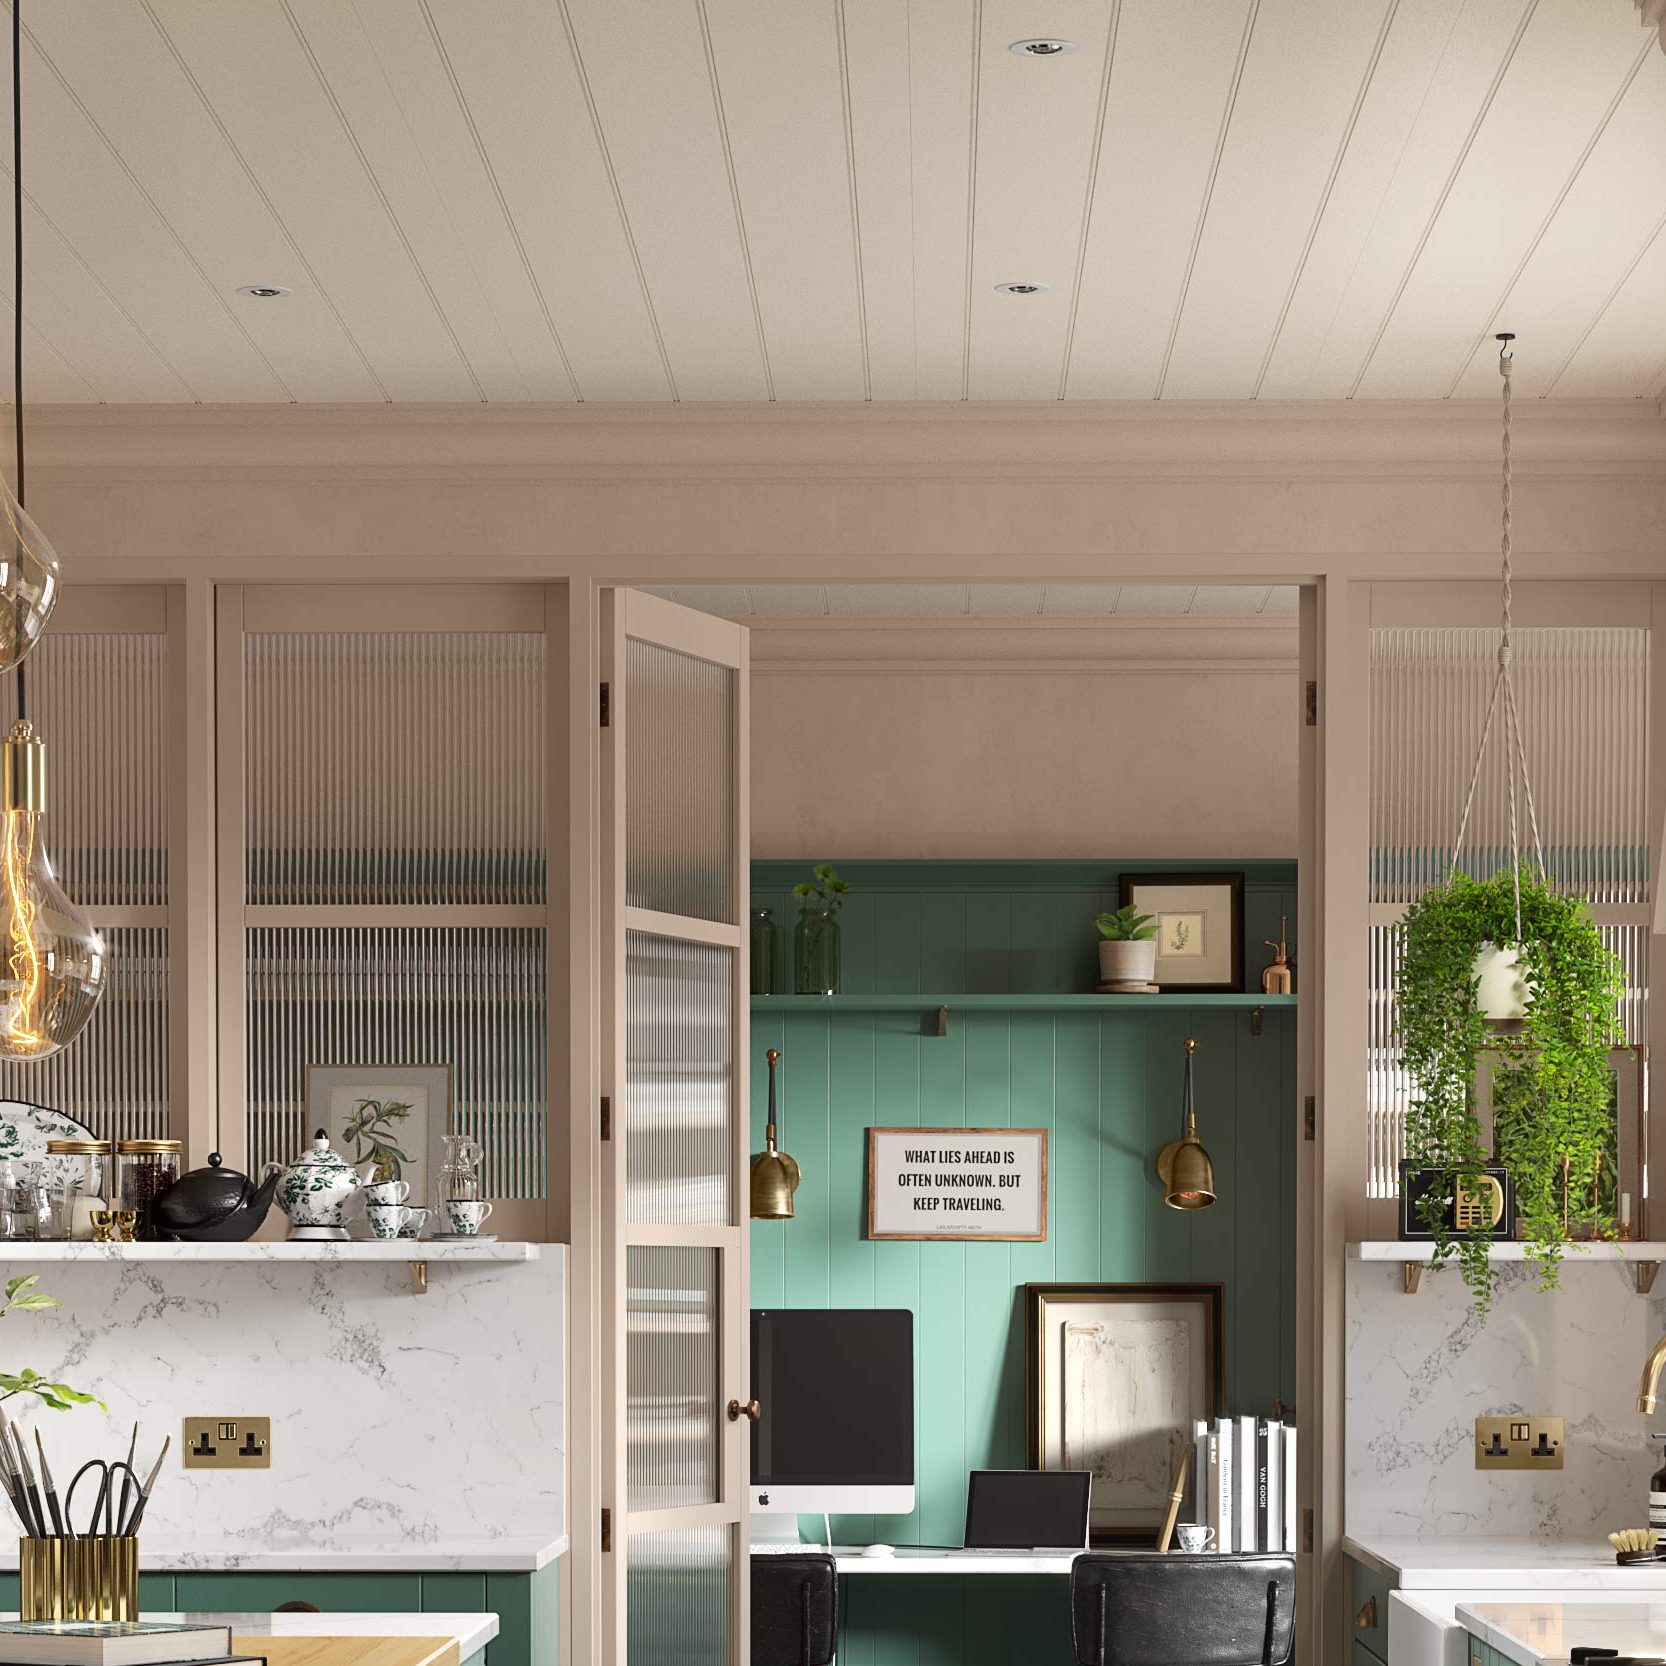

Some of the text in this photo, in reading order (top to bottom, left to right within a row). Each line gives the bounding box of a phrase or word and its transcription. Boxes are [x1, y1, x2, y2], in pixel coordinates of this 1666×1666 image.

[905, 1150, 1015, 1164] WHAT LIES AHEAD IS
[898, 1173, 1021, 1188] OFTEN UNKNOWN. BUT
[913, 1197, 1005, 1211] KEEP TRAVELING.
[1259, 1467, 1267, 1508] VAN GOGH
